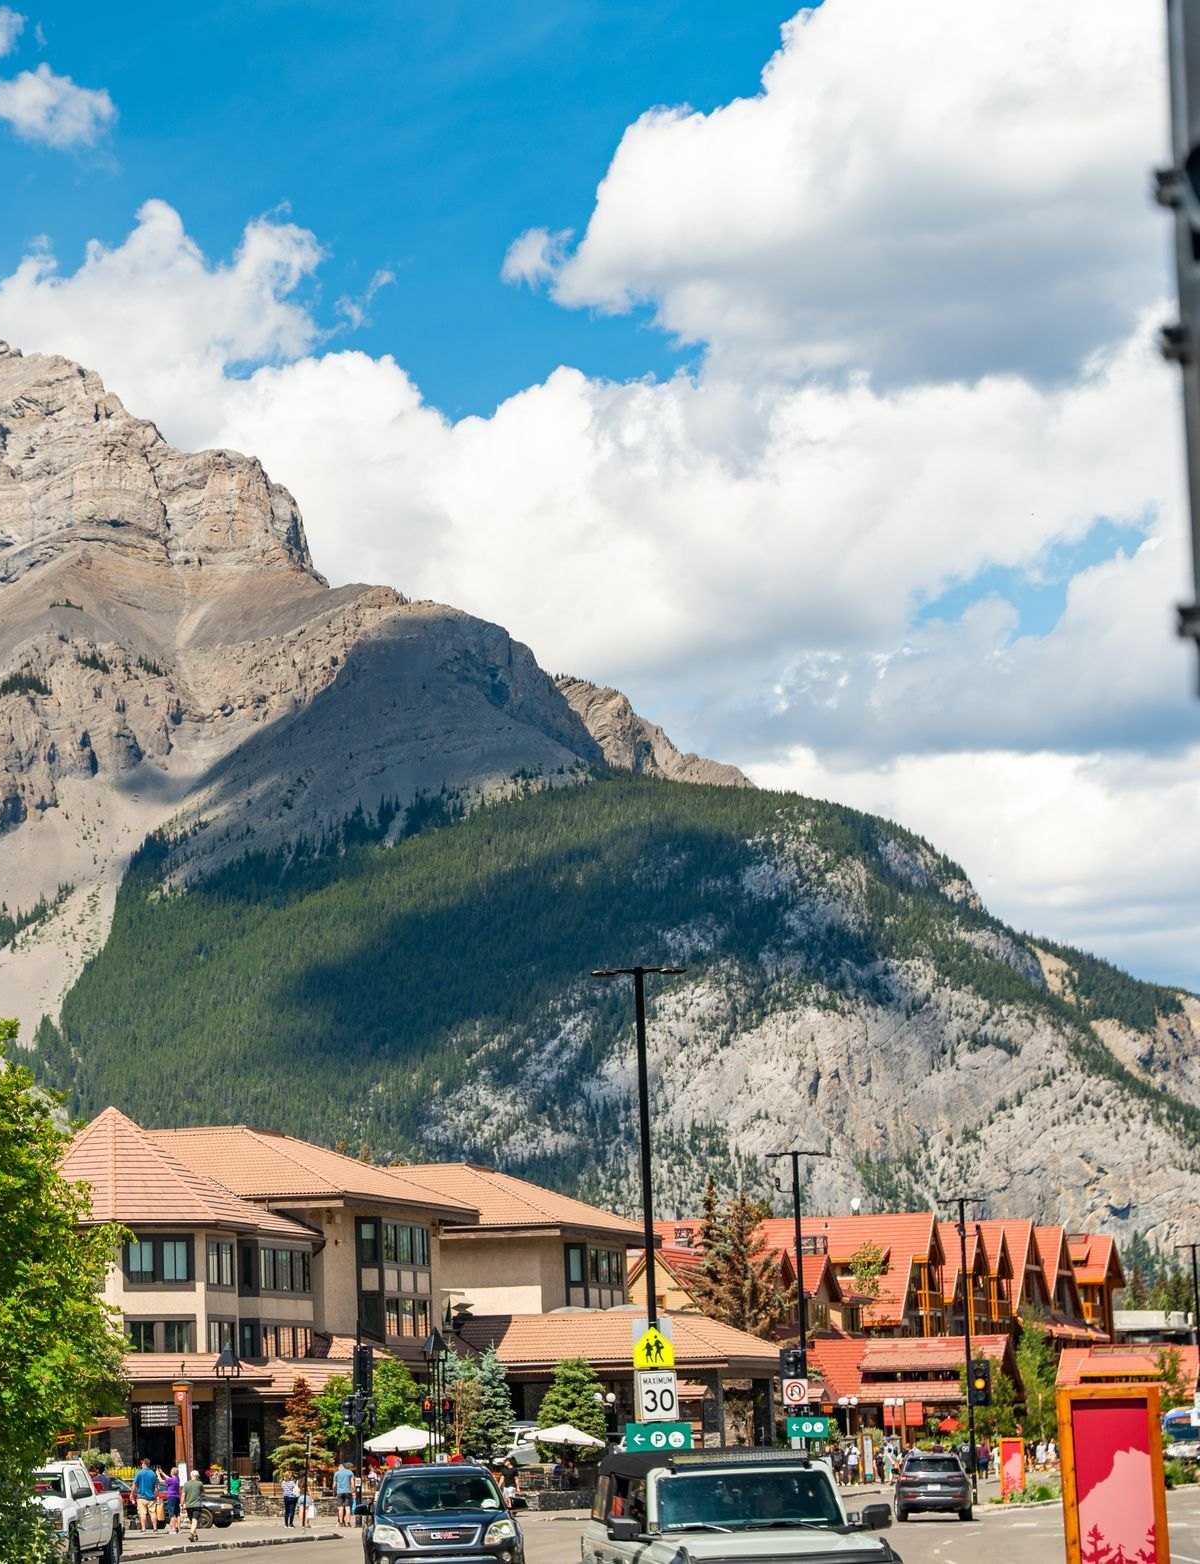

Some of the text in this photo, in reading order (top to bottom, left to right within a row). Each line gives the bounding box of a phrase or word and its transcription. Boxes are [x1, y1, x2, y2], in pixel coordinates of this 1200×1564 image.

[644, 1389, 674, 1412] 30
[655, 1433, 663, 1445] P
[430, 1531, 460, 1540] GMC
